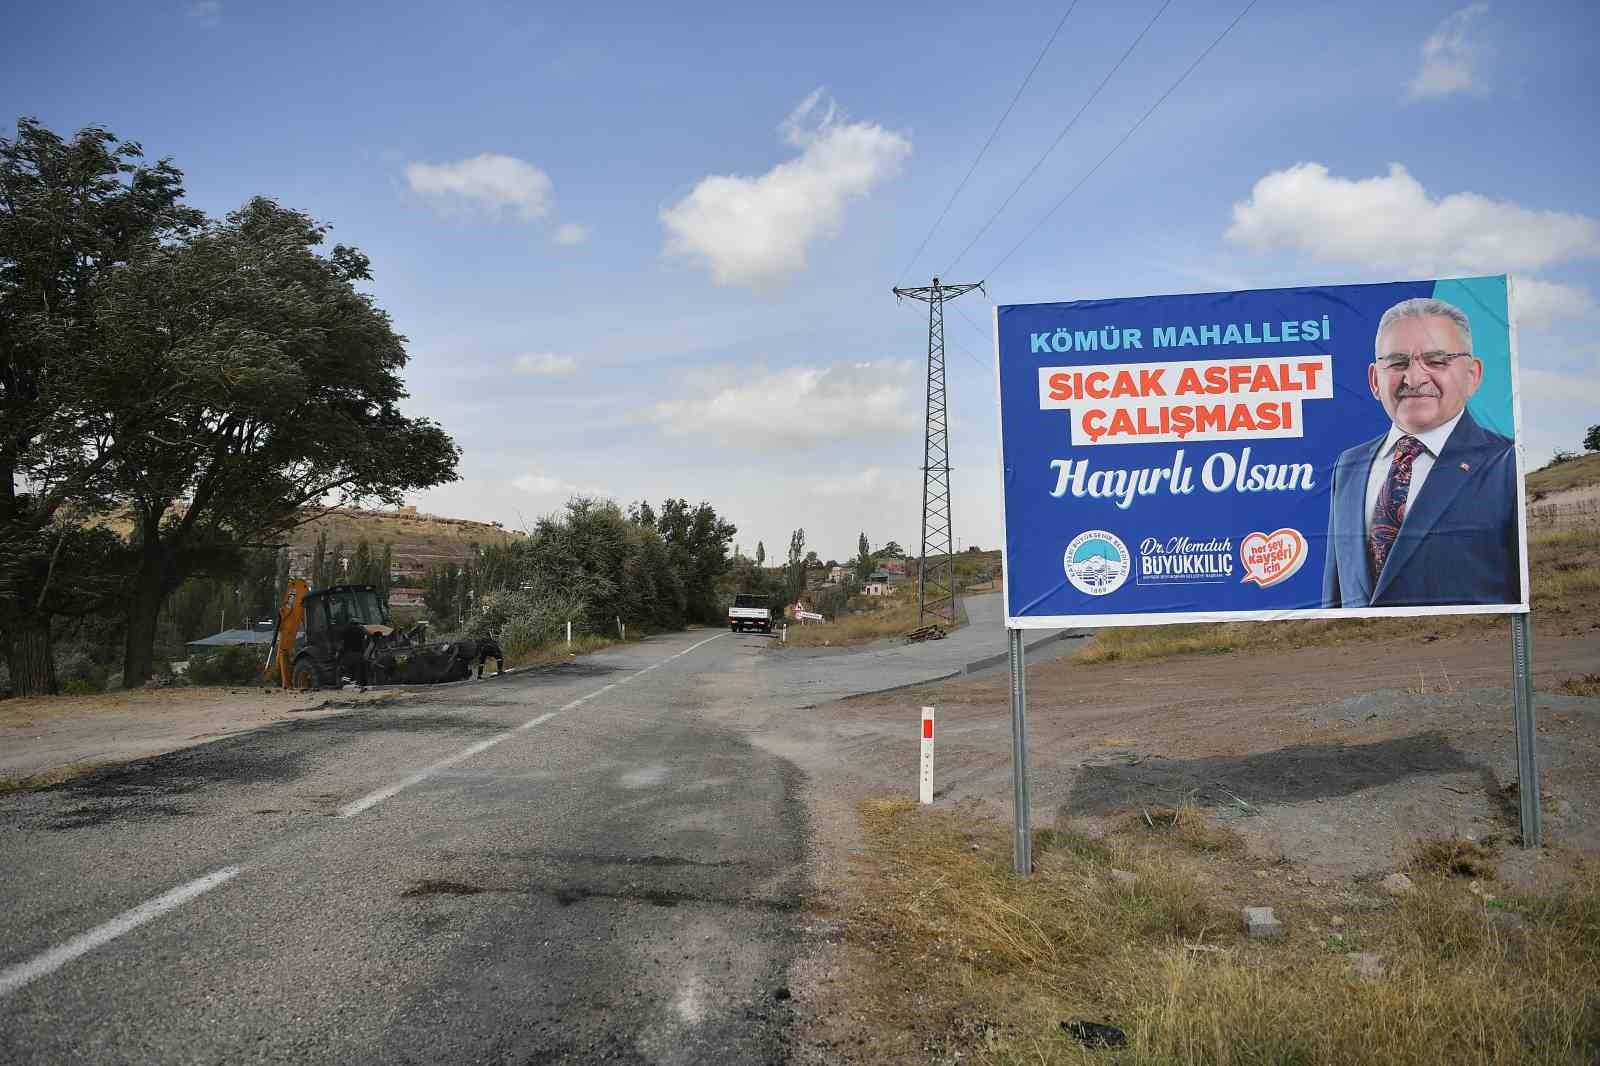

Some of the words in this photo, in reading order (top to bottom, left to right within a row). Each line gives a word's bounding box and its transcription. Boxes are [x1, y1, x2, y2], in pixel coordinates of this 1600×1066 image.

[1030, 326, 1144, 353] KÖMÜR
[1153, 314, 1331, 348] MAHALLESİ
[1049, 369, 1167, 401] SICAK
[1175, 362, 1323, 396] ASFALT
[1082, 402, 1292, 443] ÇALIŞMASI
[1049, 449, 1194, 509] Hayırlı
[1202, 447, 1316, 492] Olsun
[1140, 537, 1164, 555] Dr.
[1166, 536, 1233, 554] Memduh
[1248, 544, 1292, 564] Kayseri
